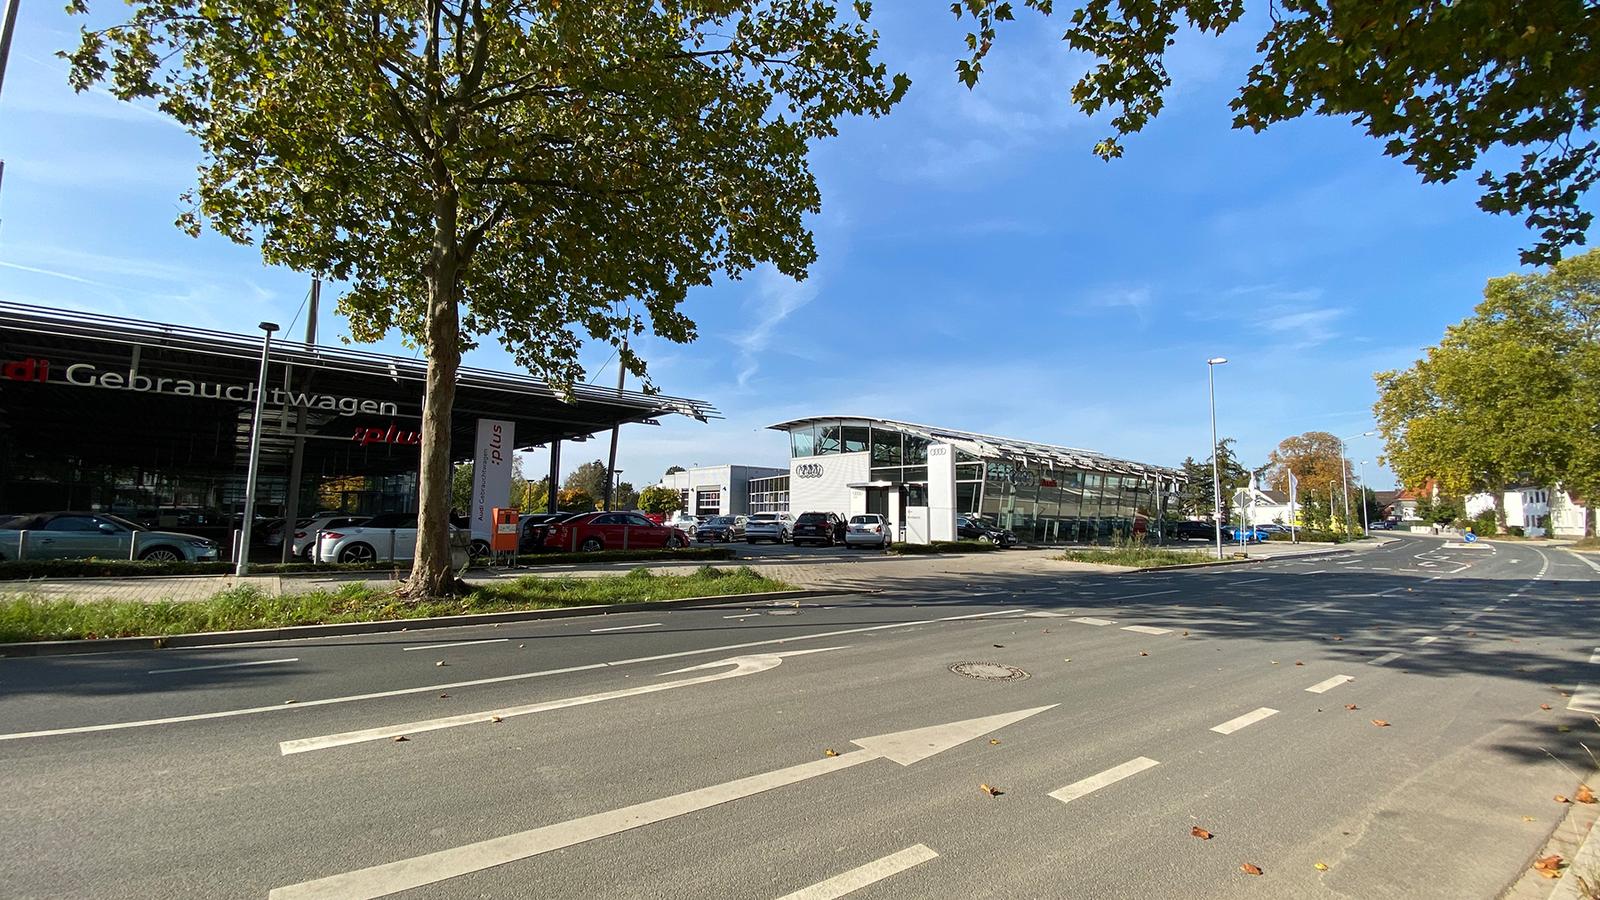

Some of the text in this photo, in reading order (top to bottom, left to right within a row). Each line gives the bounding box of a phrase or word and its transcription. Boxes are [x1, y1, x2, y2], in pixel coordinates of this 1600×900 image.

[66, 363, 398, 417] Gebrauchtwagen
[352, 420, 423, 447] :plu
[490, 424, 502, 465] :plus
